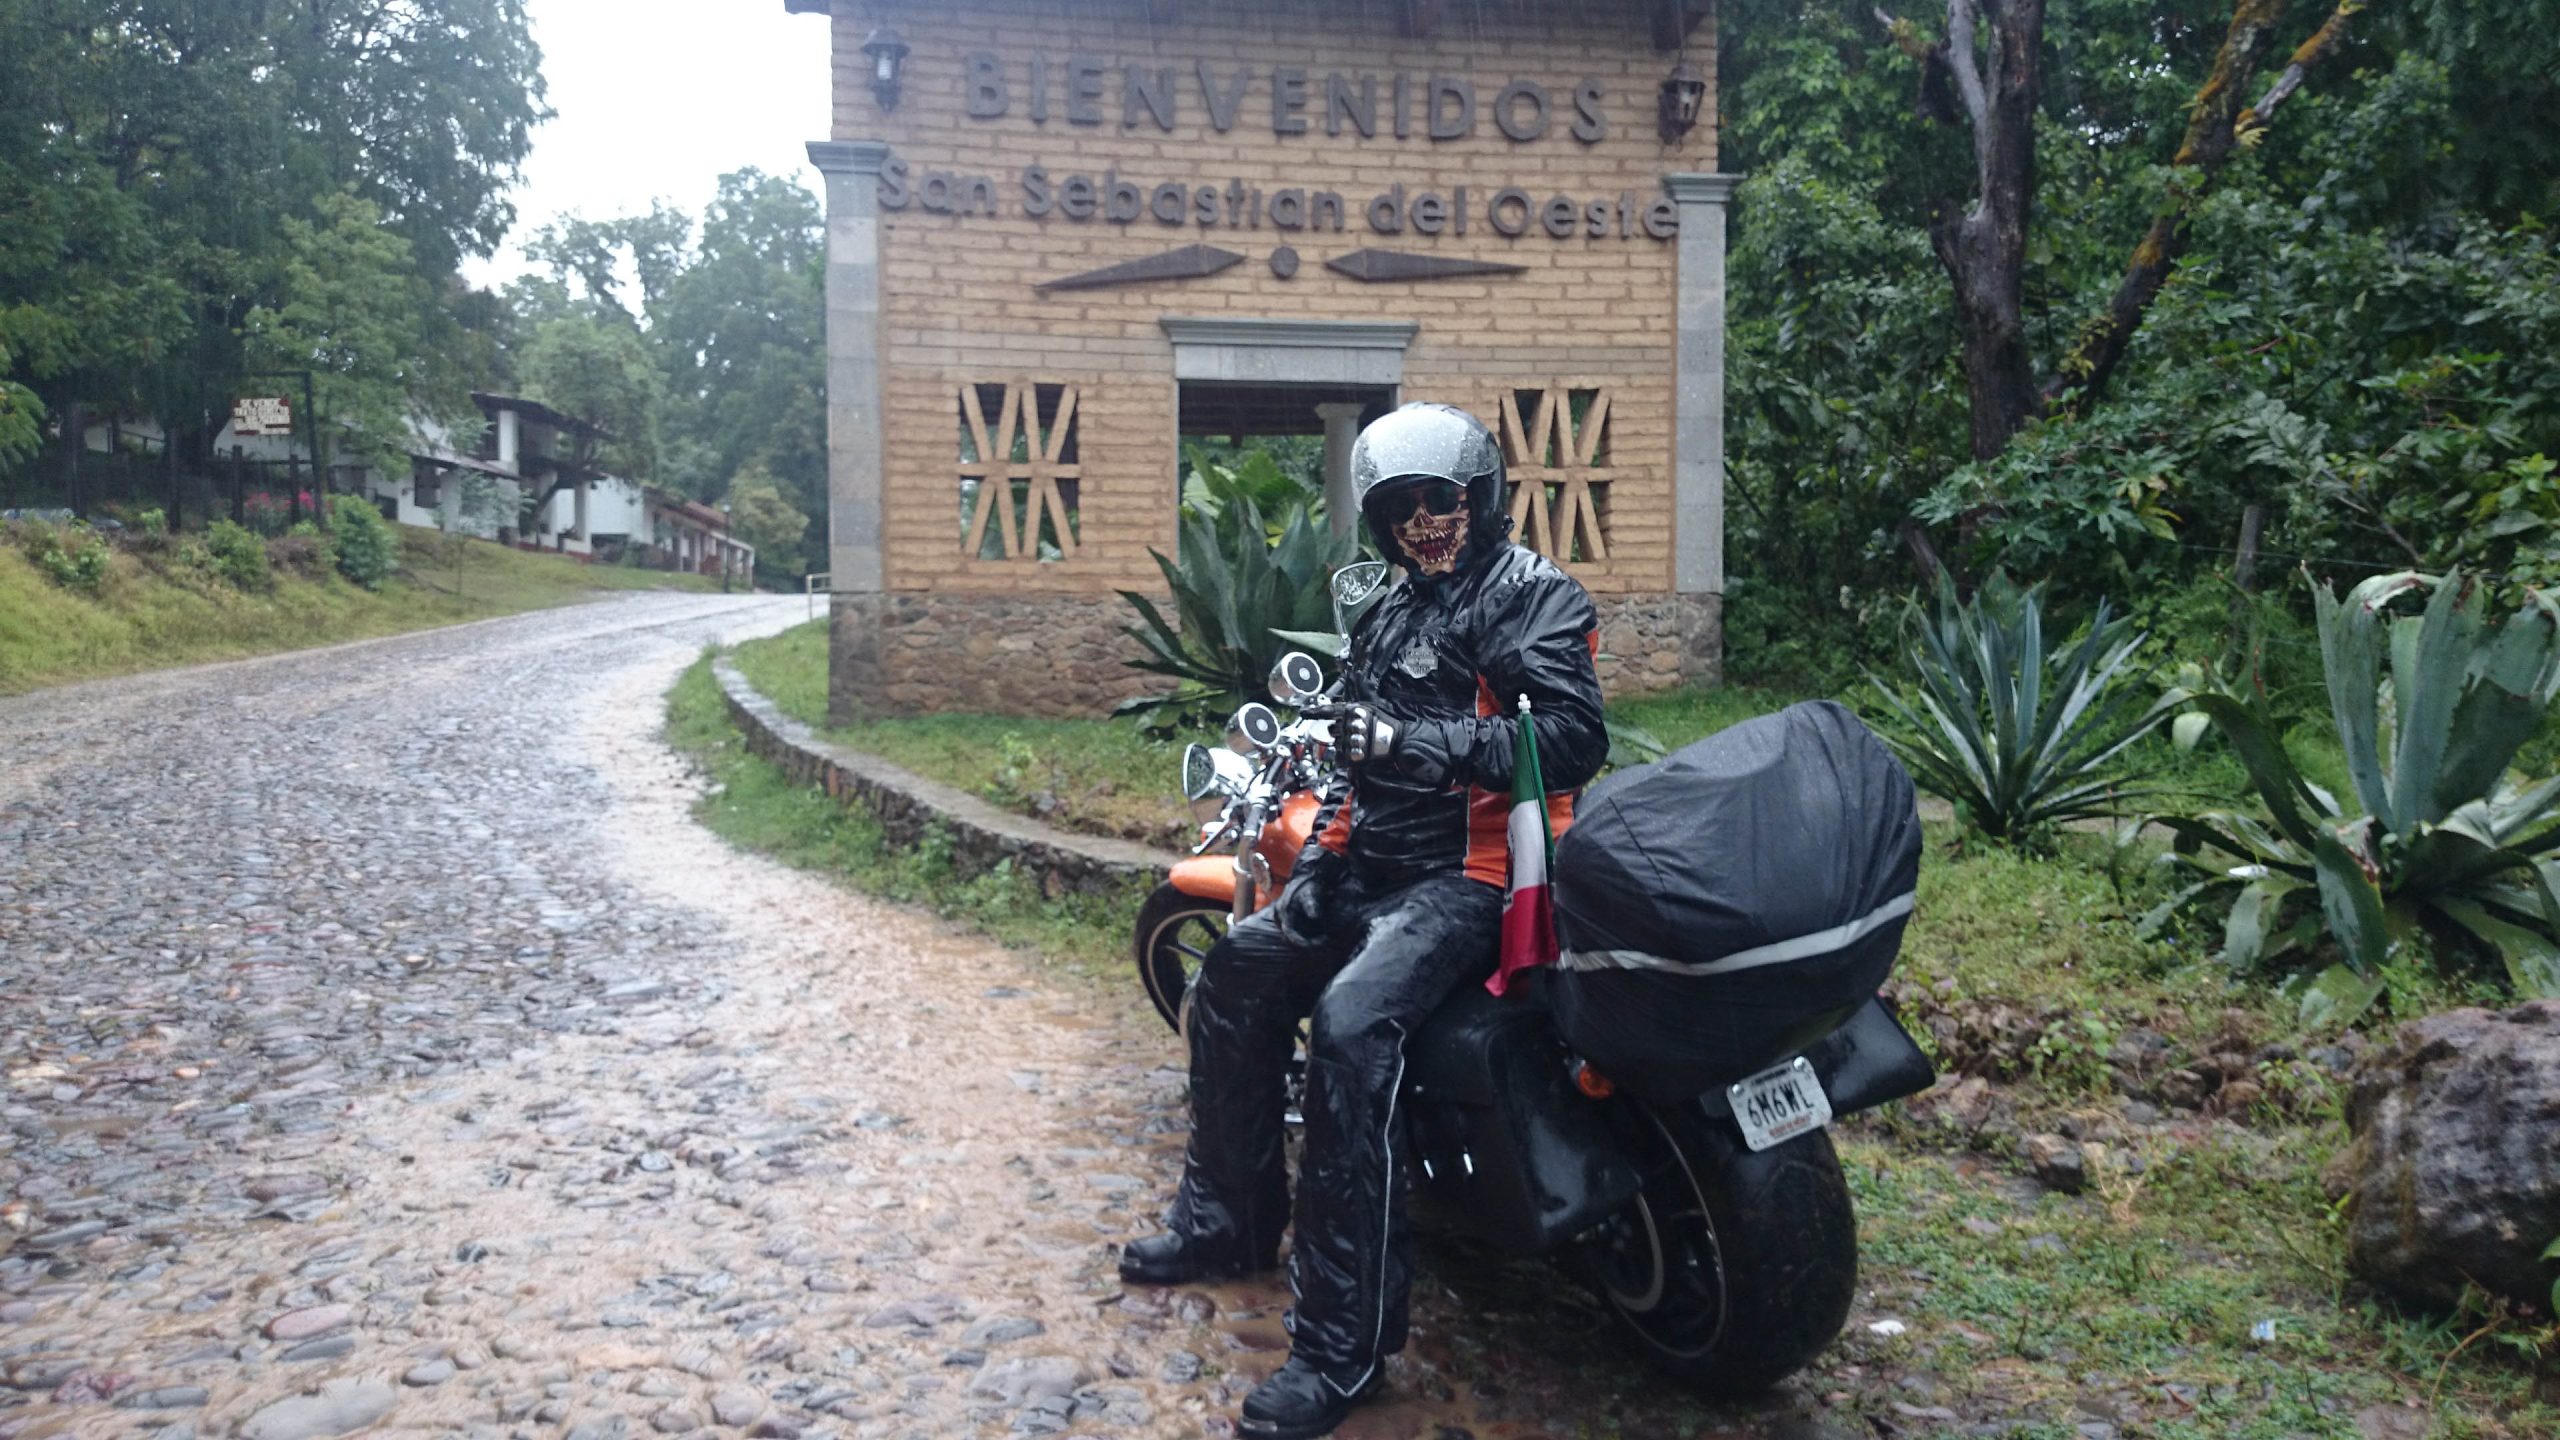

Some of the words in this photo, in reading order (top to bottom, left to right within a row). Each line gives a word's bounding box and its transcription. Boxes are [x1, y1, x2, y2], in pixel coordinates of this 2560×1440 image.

[966, 52, 1610, 144] BIENVENIDOS
[879, 156, 998, 217] San
[1022, 163, 1345, 233] Sebastian
[1368, 183, 1467, 238] del
[1489, 186, 1679, 240] Oeste
[1747, 1080, 1815, 1128] 6M6WL
